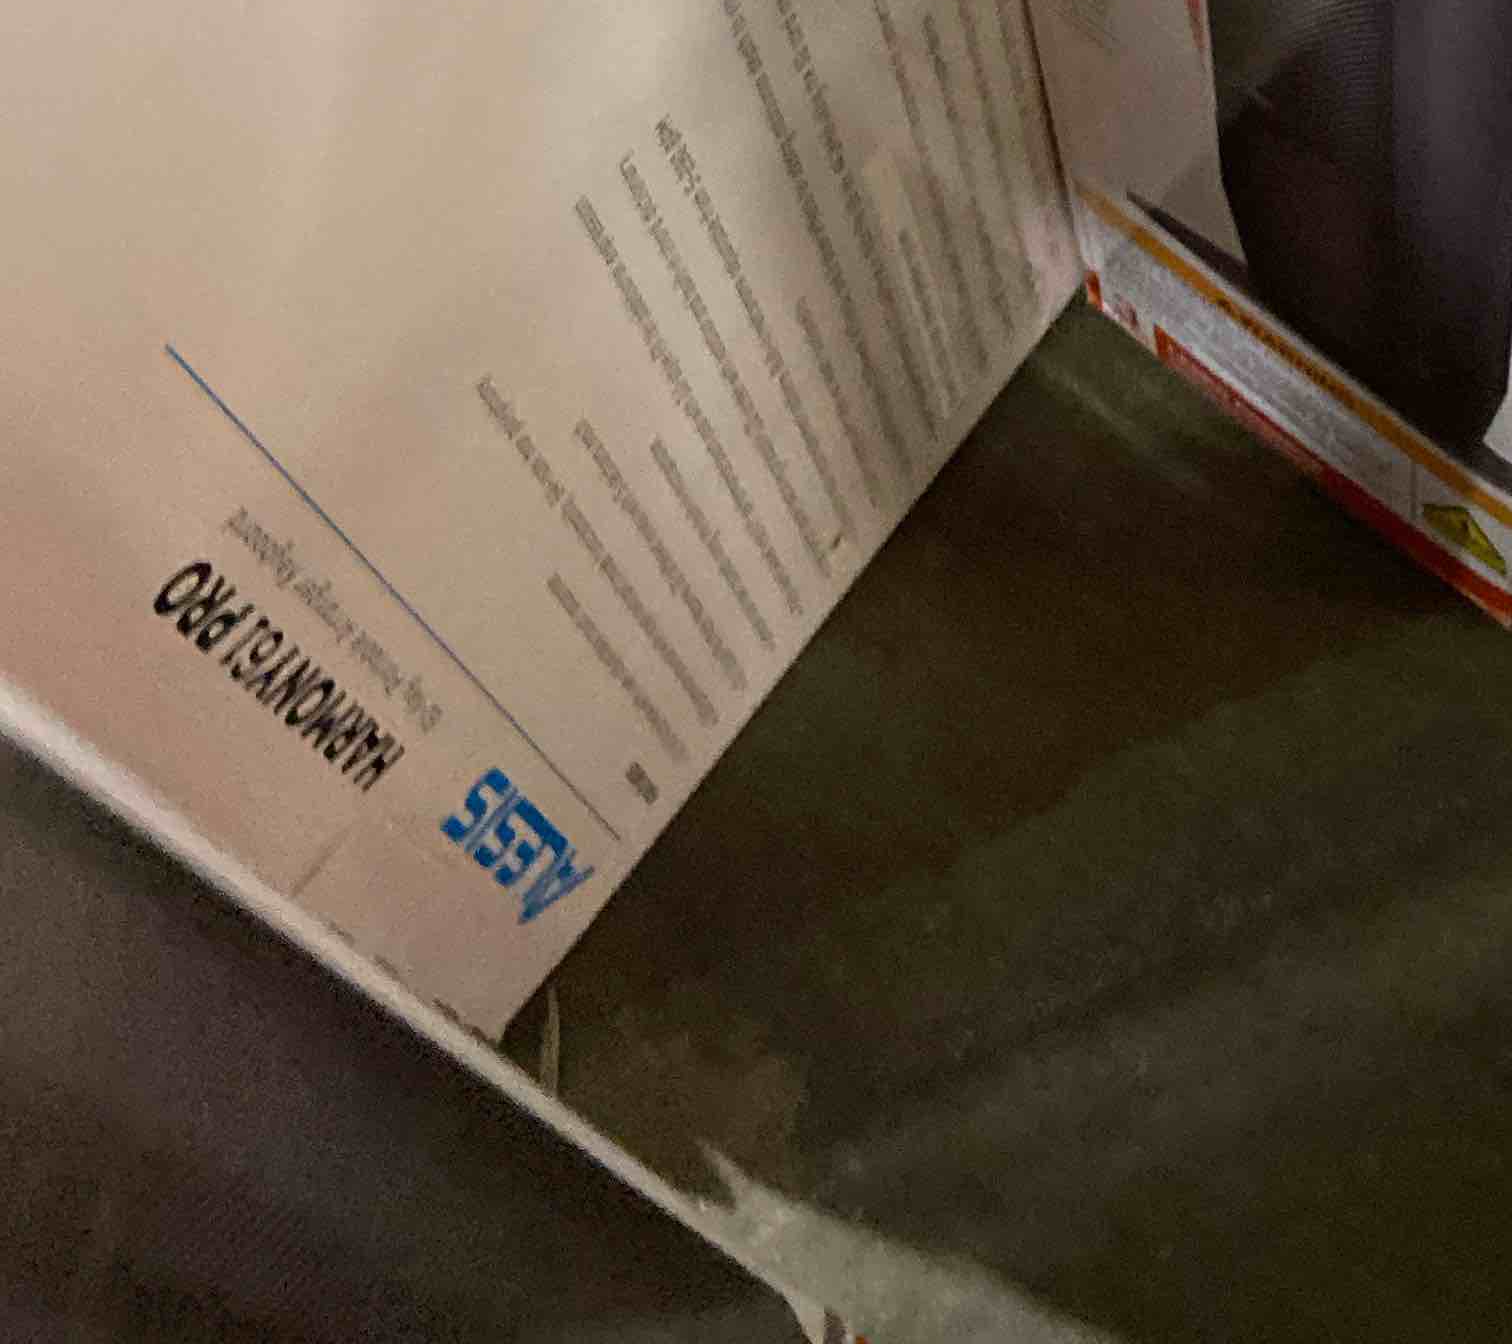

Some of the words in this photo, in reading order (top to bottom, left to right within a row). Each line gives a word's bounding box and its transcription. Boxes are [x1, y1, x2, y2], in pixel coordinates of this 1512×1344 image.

[153, 561, 256, 656] PRO
[221, 617, 405, 793] HARMONY61
[440, 767, 595, 924] ALESIS
